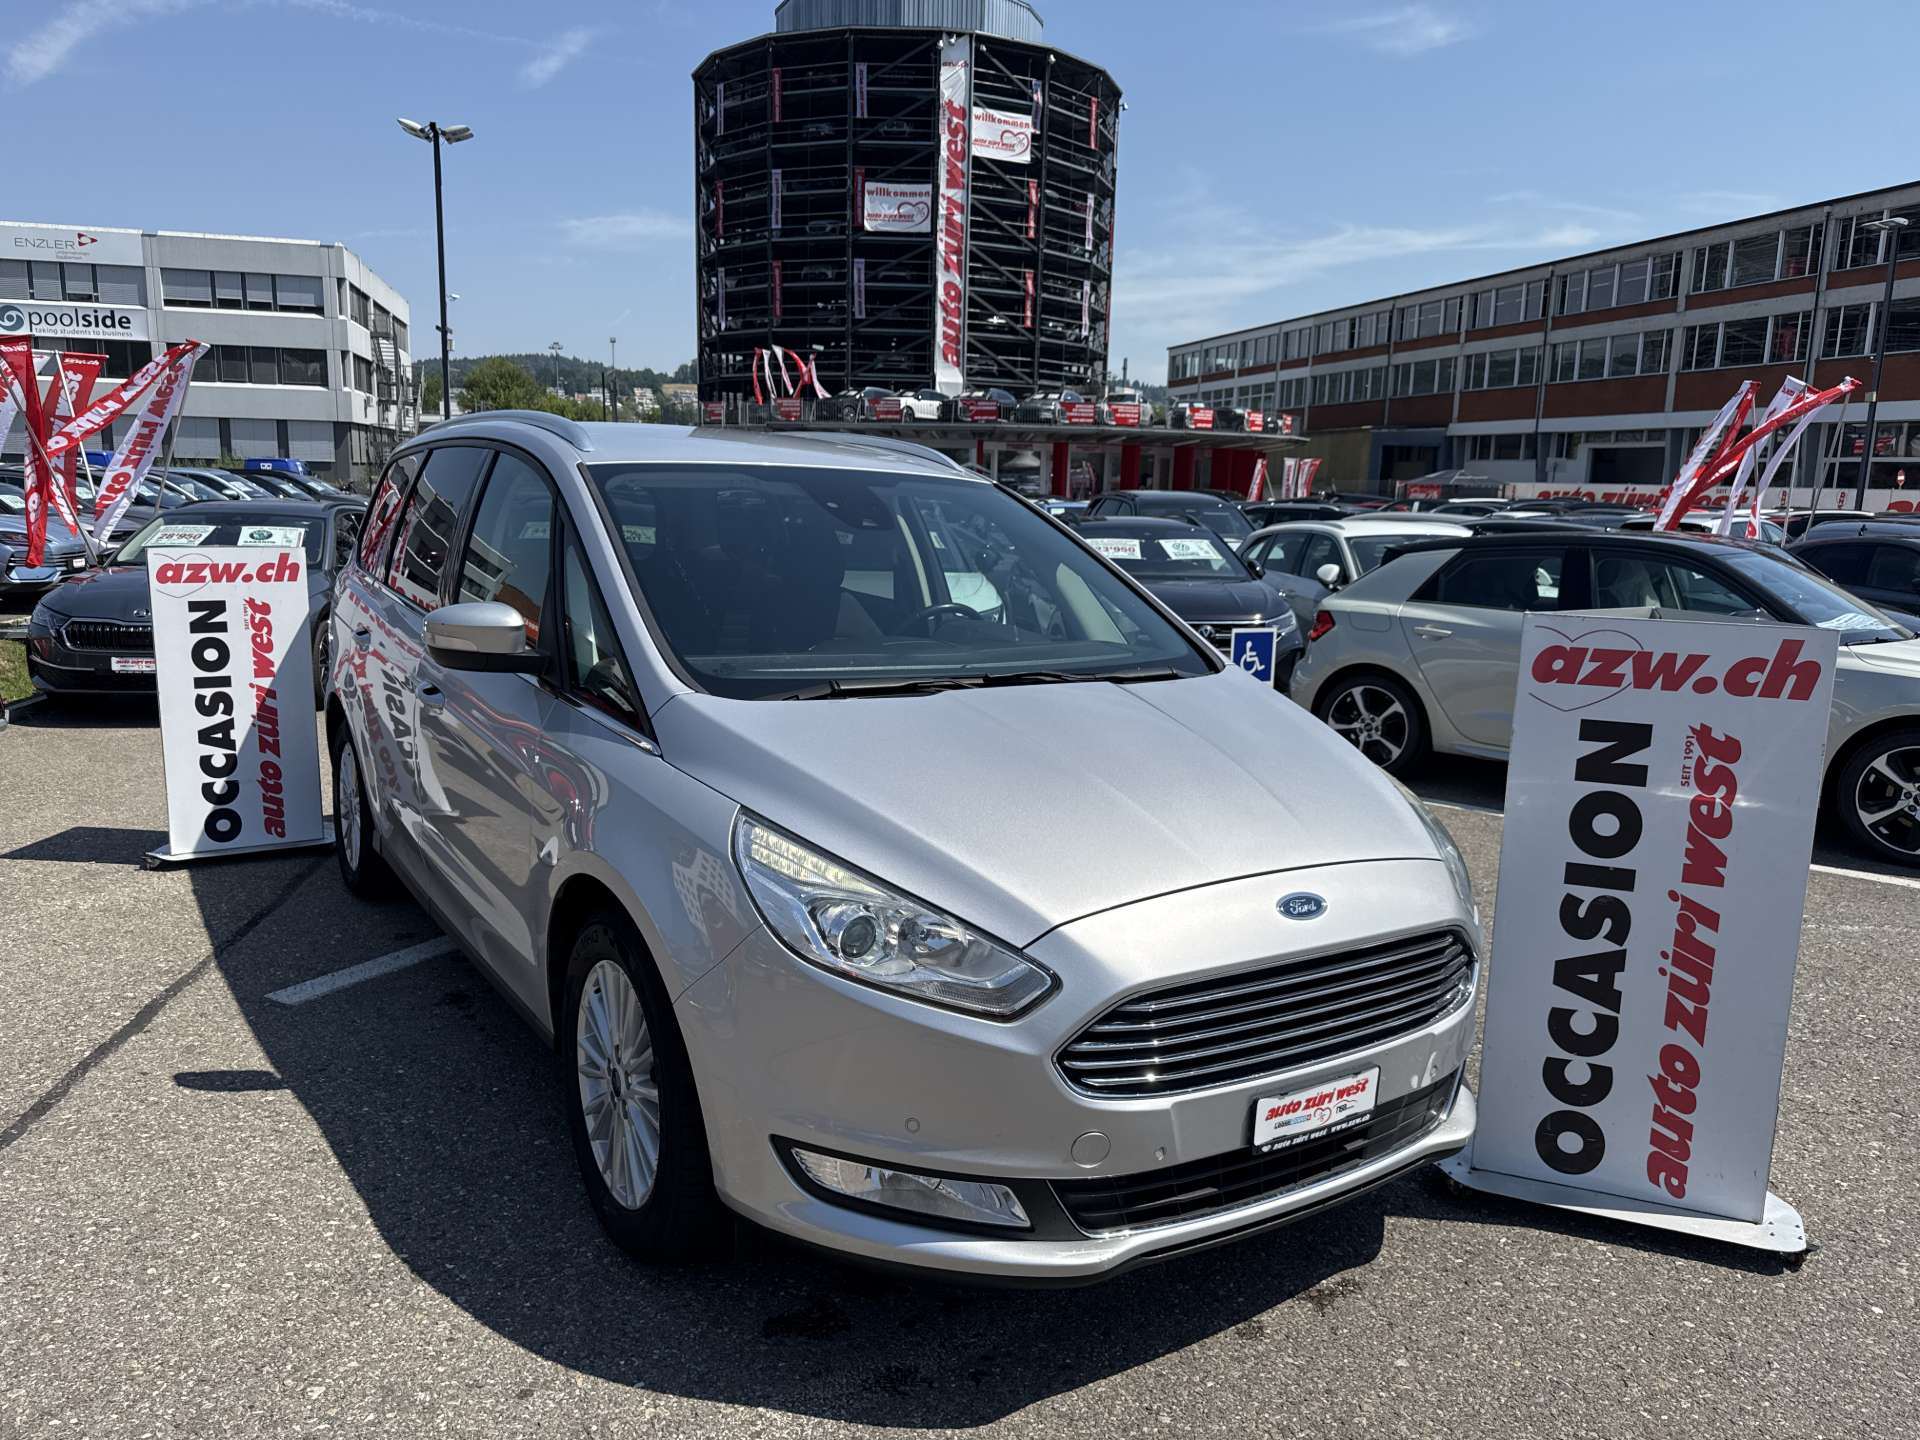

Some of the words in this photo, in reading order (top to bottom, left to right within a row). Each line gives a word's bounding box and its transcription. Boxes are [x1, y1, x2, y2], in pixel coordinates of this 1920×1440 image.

[944, 99, 967, 189] west
[974, 112, 1030, 129] willkommen
[866, 187, 930, 197] willkommen
[14, 237, 75, 250] ENZLER
[940, 193, 965, 280] züri
[28, 308, 131, 332] poolside
[35, 327, 58, 336] taking
[60, 328, 91, 336] students
[939, 281, 962, 368] auto
[156, 553, 300, 584] azw.ch
[243, 596, 276, 678] west
[1531, 638, 1822, 701] azw.ch
[187, 600, 243, 843] OCCASION
[249, 682, 281, 757] züri
[1683, 735, 1696, 760] 1991
[256, 759, 287, 839] auto
[1680, 764, 1693, 788] SEIT
[1680, 722, 1743, 888] west
[1290, 899, 1317, 914] Ford
[1534, 718, 1653, 1175] OCCASION
[1658, 889, 1721, 1048] züri
[1265, 1100, 1303, 1121] auto
[1303, 1088, 1336, 1111] züri
[1336, 1078, 1369, 1100] west
[1646, 1043, 1702, 1199] auto
[1272, 1139, 1292, 1151] auto
[1309, 1128, 1328, 1139] west
